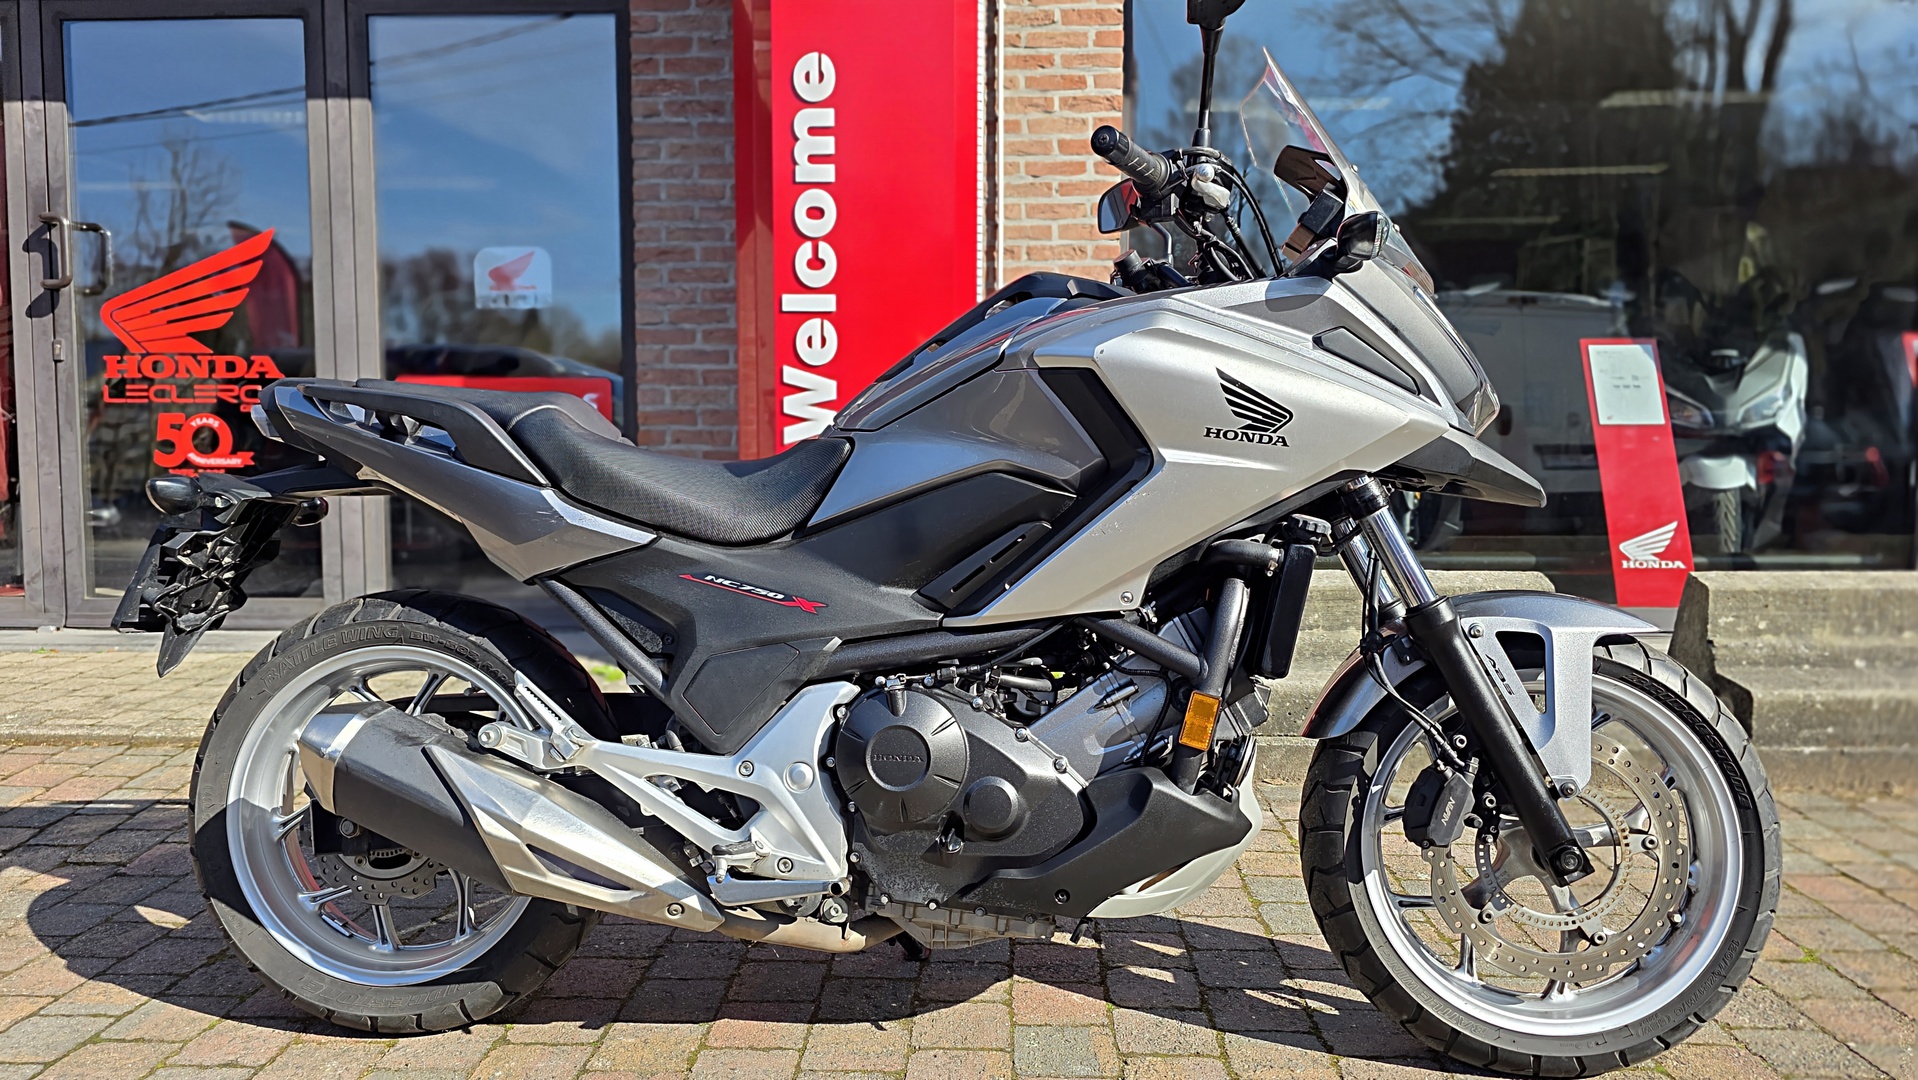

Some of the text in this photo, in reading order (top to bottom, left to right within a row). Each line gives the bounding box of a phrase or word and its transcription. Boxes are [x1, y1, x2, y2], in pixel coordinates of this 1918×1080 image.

[782, 51, 838, 444] Welcome
[103, 355, 285, 379] HONDA
[103, 384, 262, 403] LECLERC
[153, 412, 233, 468] 50
[190, 417, 220, 428] YEARS
[1203, 427, 1290, 447] HONDA
[1622, 560, 1686, 569] HONDA
[263, 631, 337, 685] BATTLE
[340, 624, 400, 645] WING
[1485, 653, 1515, 696] ABS
[873, 754, 924, 762] HONDA
[1621, 672, 1752, 811] BRIDGESTONE
[1381, 948, 1420, 992] WING
[1416, 990, 1490, 1039] BATTLE
